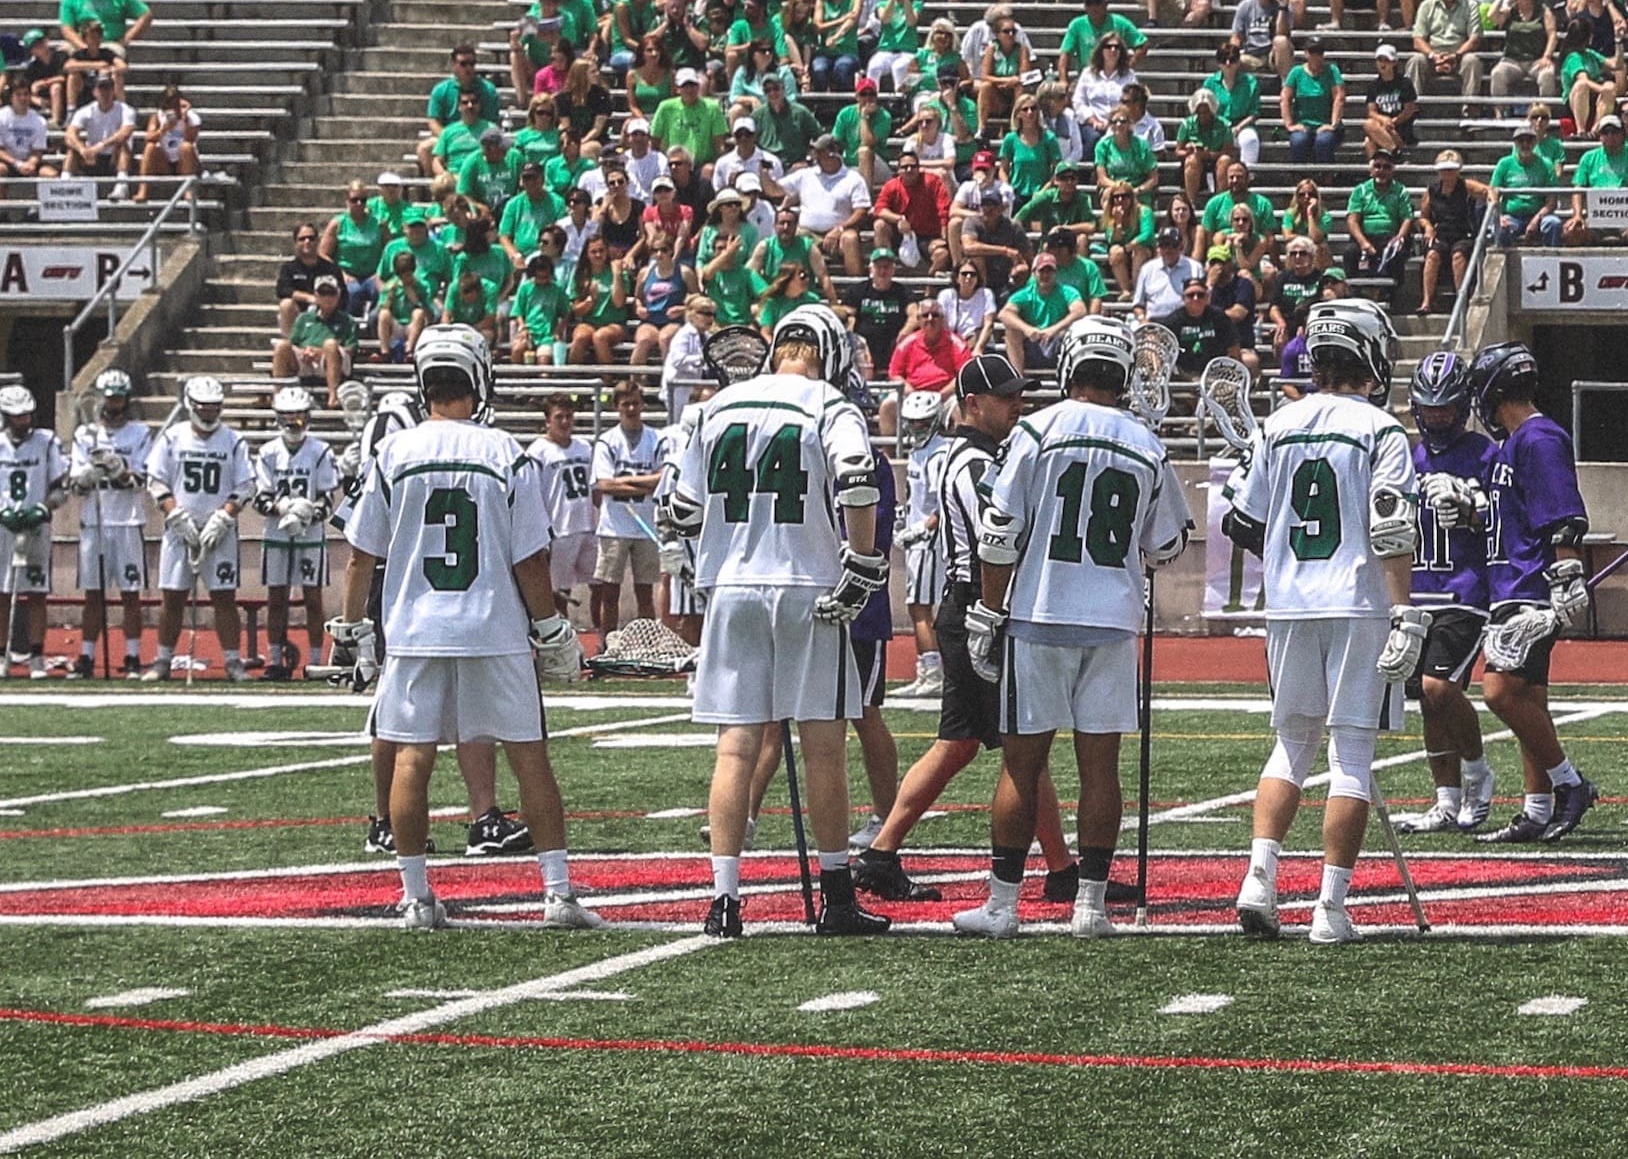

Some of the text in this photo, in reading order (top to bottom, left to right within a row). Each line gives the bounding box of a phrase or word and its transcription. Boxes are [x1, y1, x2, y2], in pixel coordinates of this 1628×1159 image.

[1, 253, 121, 292] A B
[1559, 262, 1585, 303] B
[1086, 334, 1128, 350] BEARS
[1309, 324, 1345, 335] BEARS
[10, 470, 27, 500] 8
[184, 461, 221, 494] 50
[563, 466, 589, 500] 19
[707, 422, 808, 524] 44
[1048, 462, 1140, 568] 18
[1290, 458, 1342, 561] 9
[423, 487, 480, 591] 3
[983, 532, 1007, 546] STX
